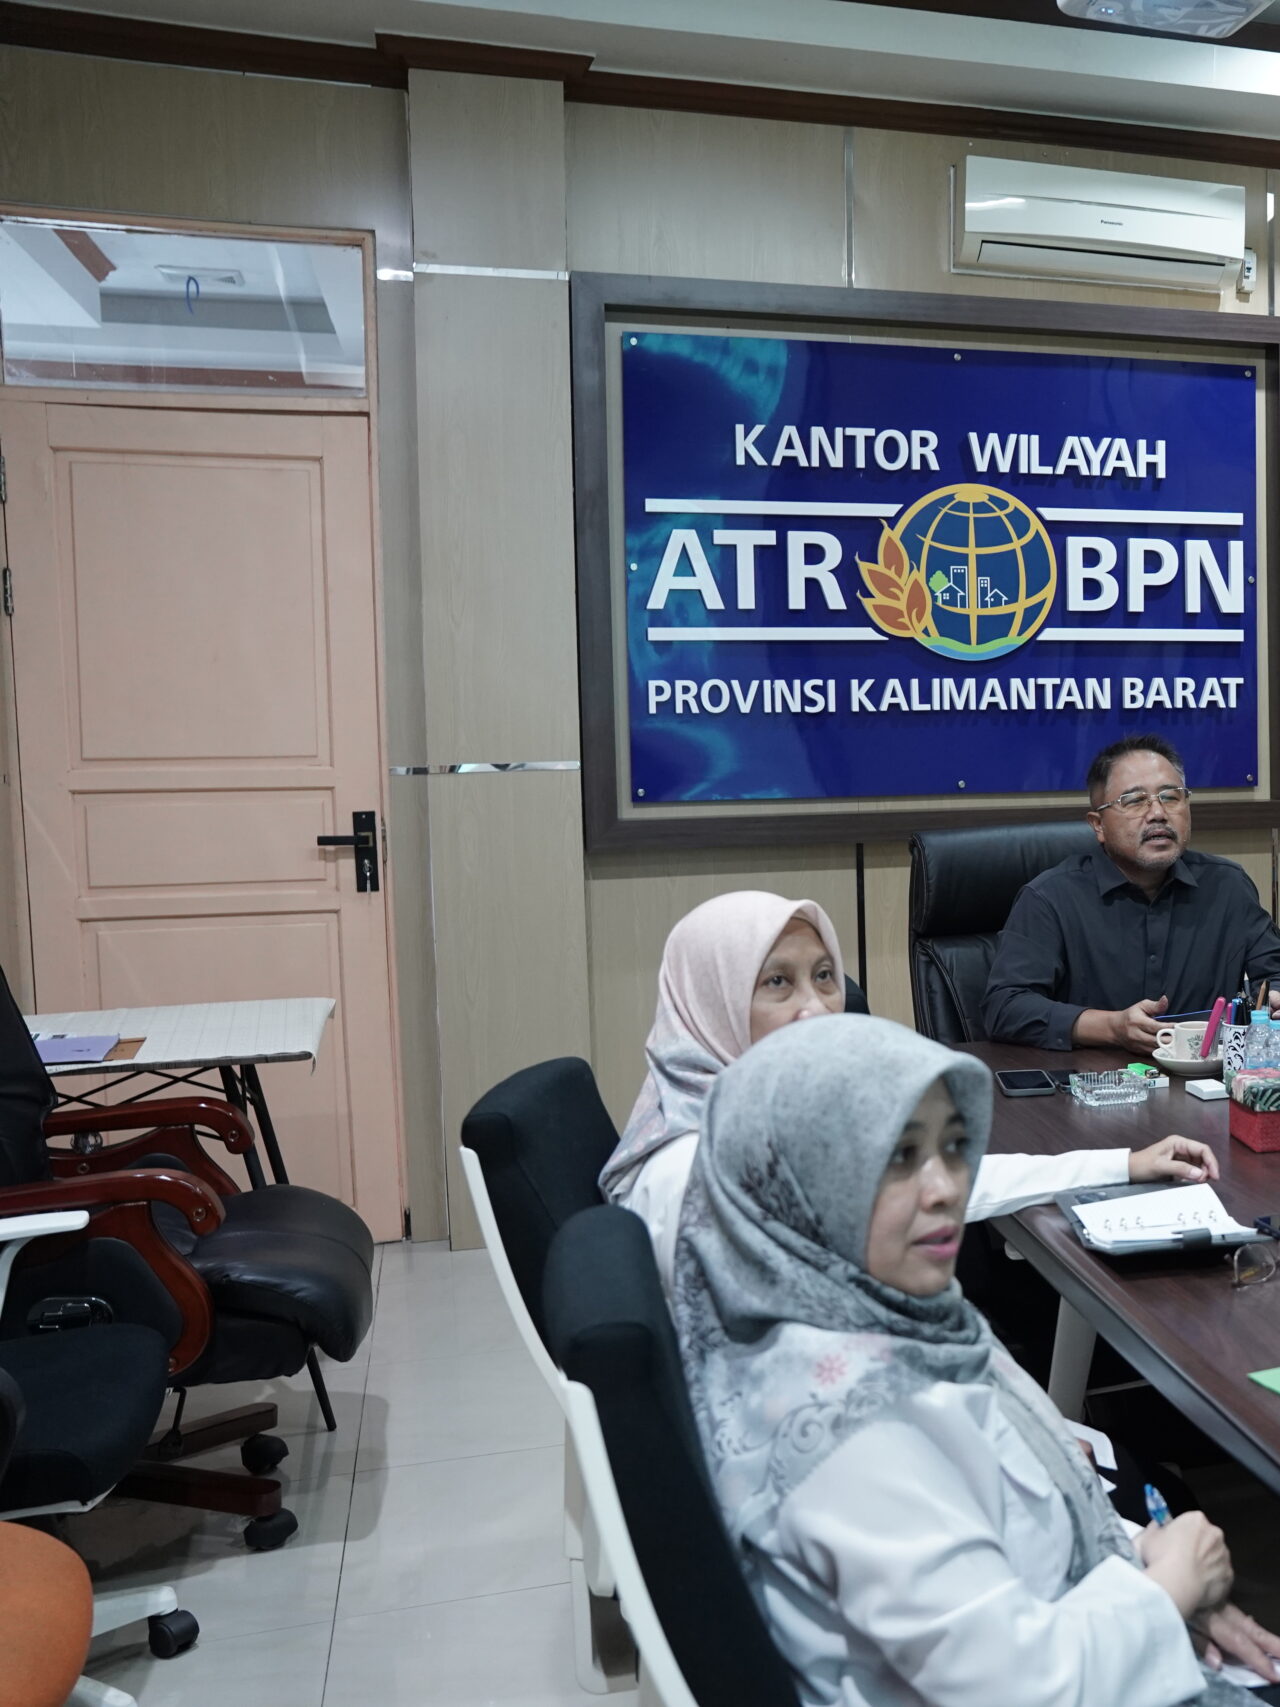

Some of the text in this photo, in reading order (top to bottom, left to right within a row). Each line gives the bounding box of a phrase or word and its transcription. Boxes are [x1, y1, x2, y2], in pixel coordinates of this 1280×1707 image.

[734, 424, 1166, 478] KANTOR WILAYAH
[646, 528, 1245, 614] ATR BPN
[647, 676, 1244, 714] PROVINSI KALIMANTAN BARAT
